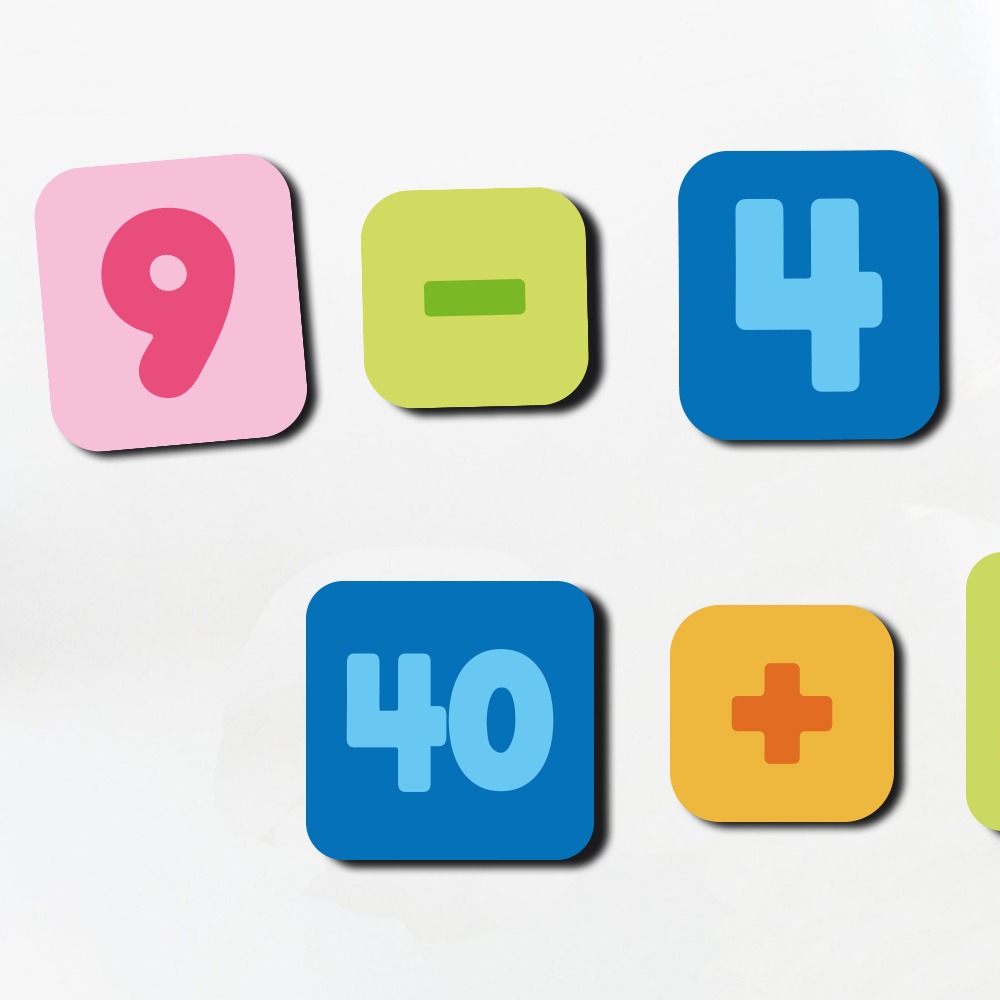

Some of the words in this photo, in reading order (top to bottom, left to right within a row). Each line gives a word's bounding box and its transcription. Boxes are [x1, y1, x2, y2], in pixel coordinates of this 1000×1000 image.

[102, 208, 235, 398] 9
[736, 199, 882, 391] 4
[347, 649, 553, 792] 40
[732, 663, 832, 764] +
